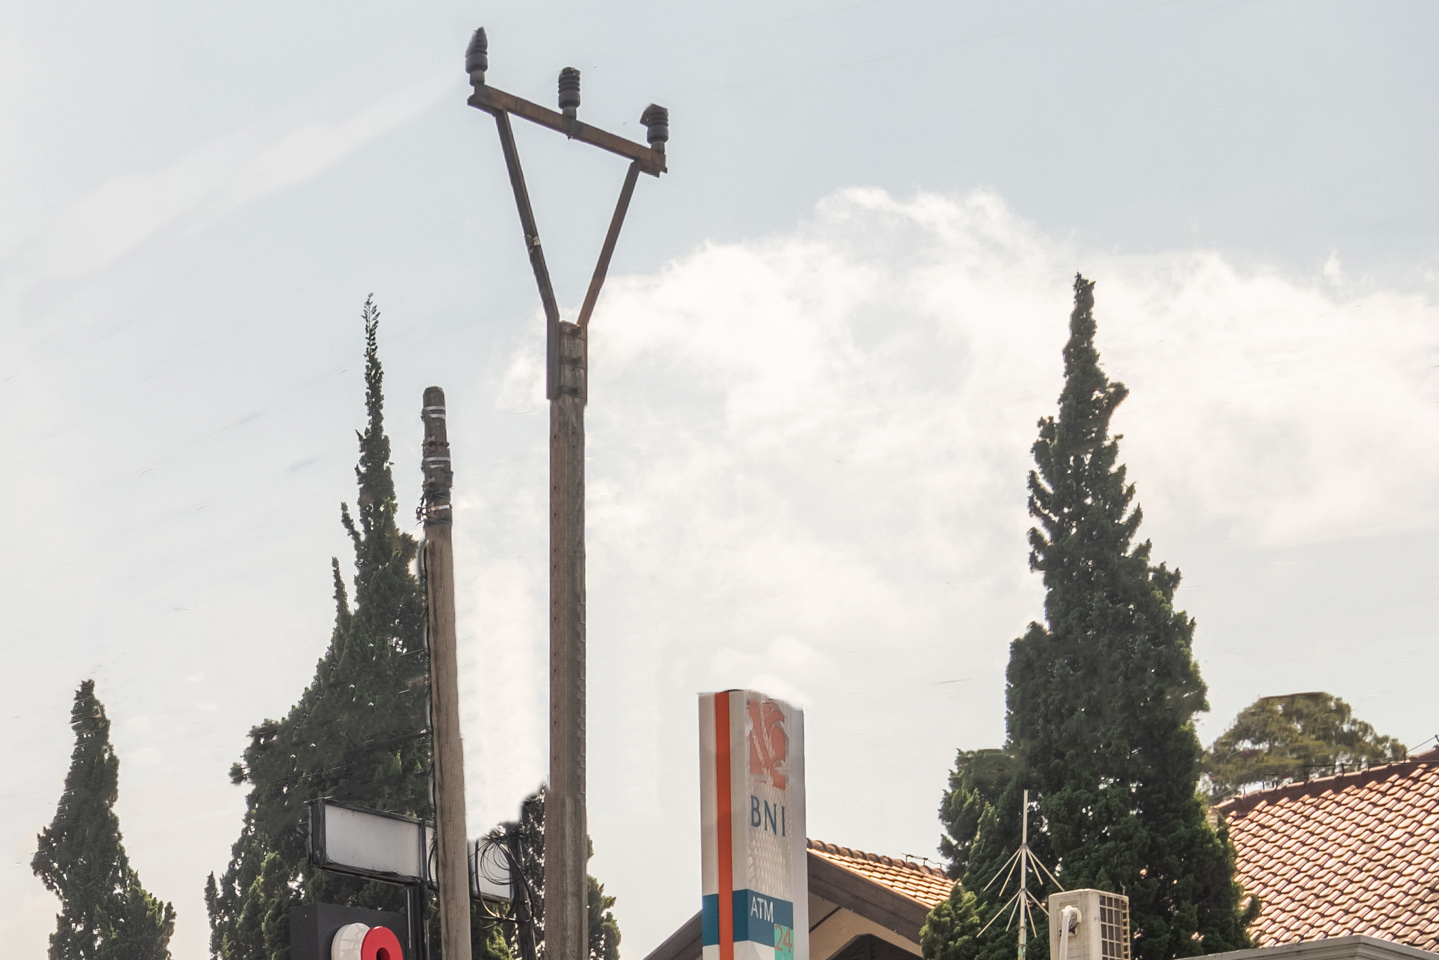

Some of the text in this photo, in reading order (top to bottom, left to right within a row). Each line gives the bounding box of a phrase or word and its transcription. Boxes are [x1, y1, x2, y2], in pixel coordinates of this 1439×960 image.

[750, 795, 786, 837] BNI
[750, 895, 774, 923] ATM
[774, 924, 792, 953] 24
